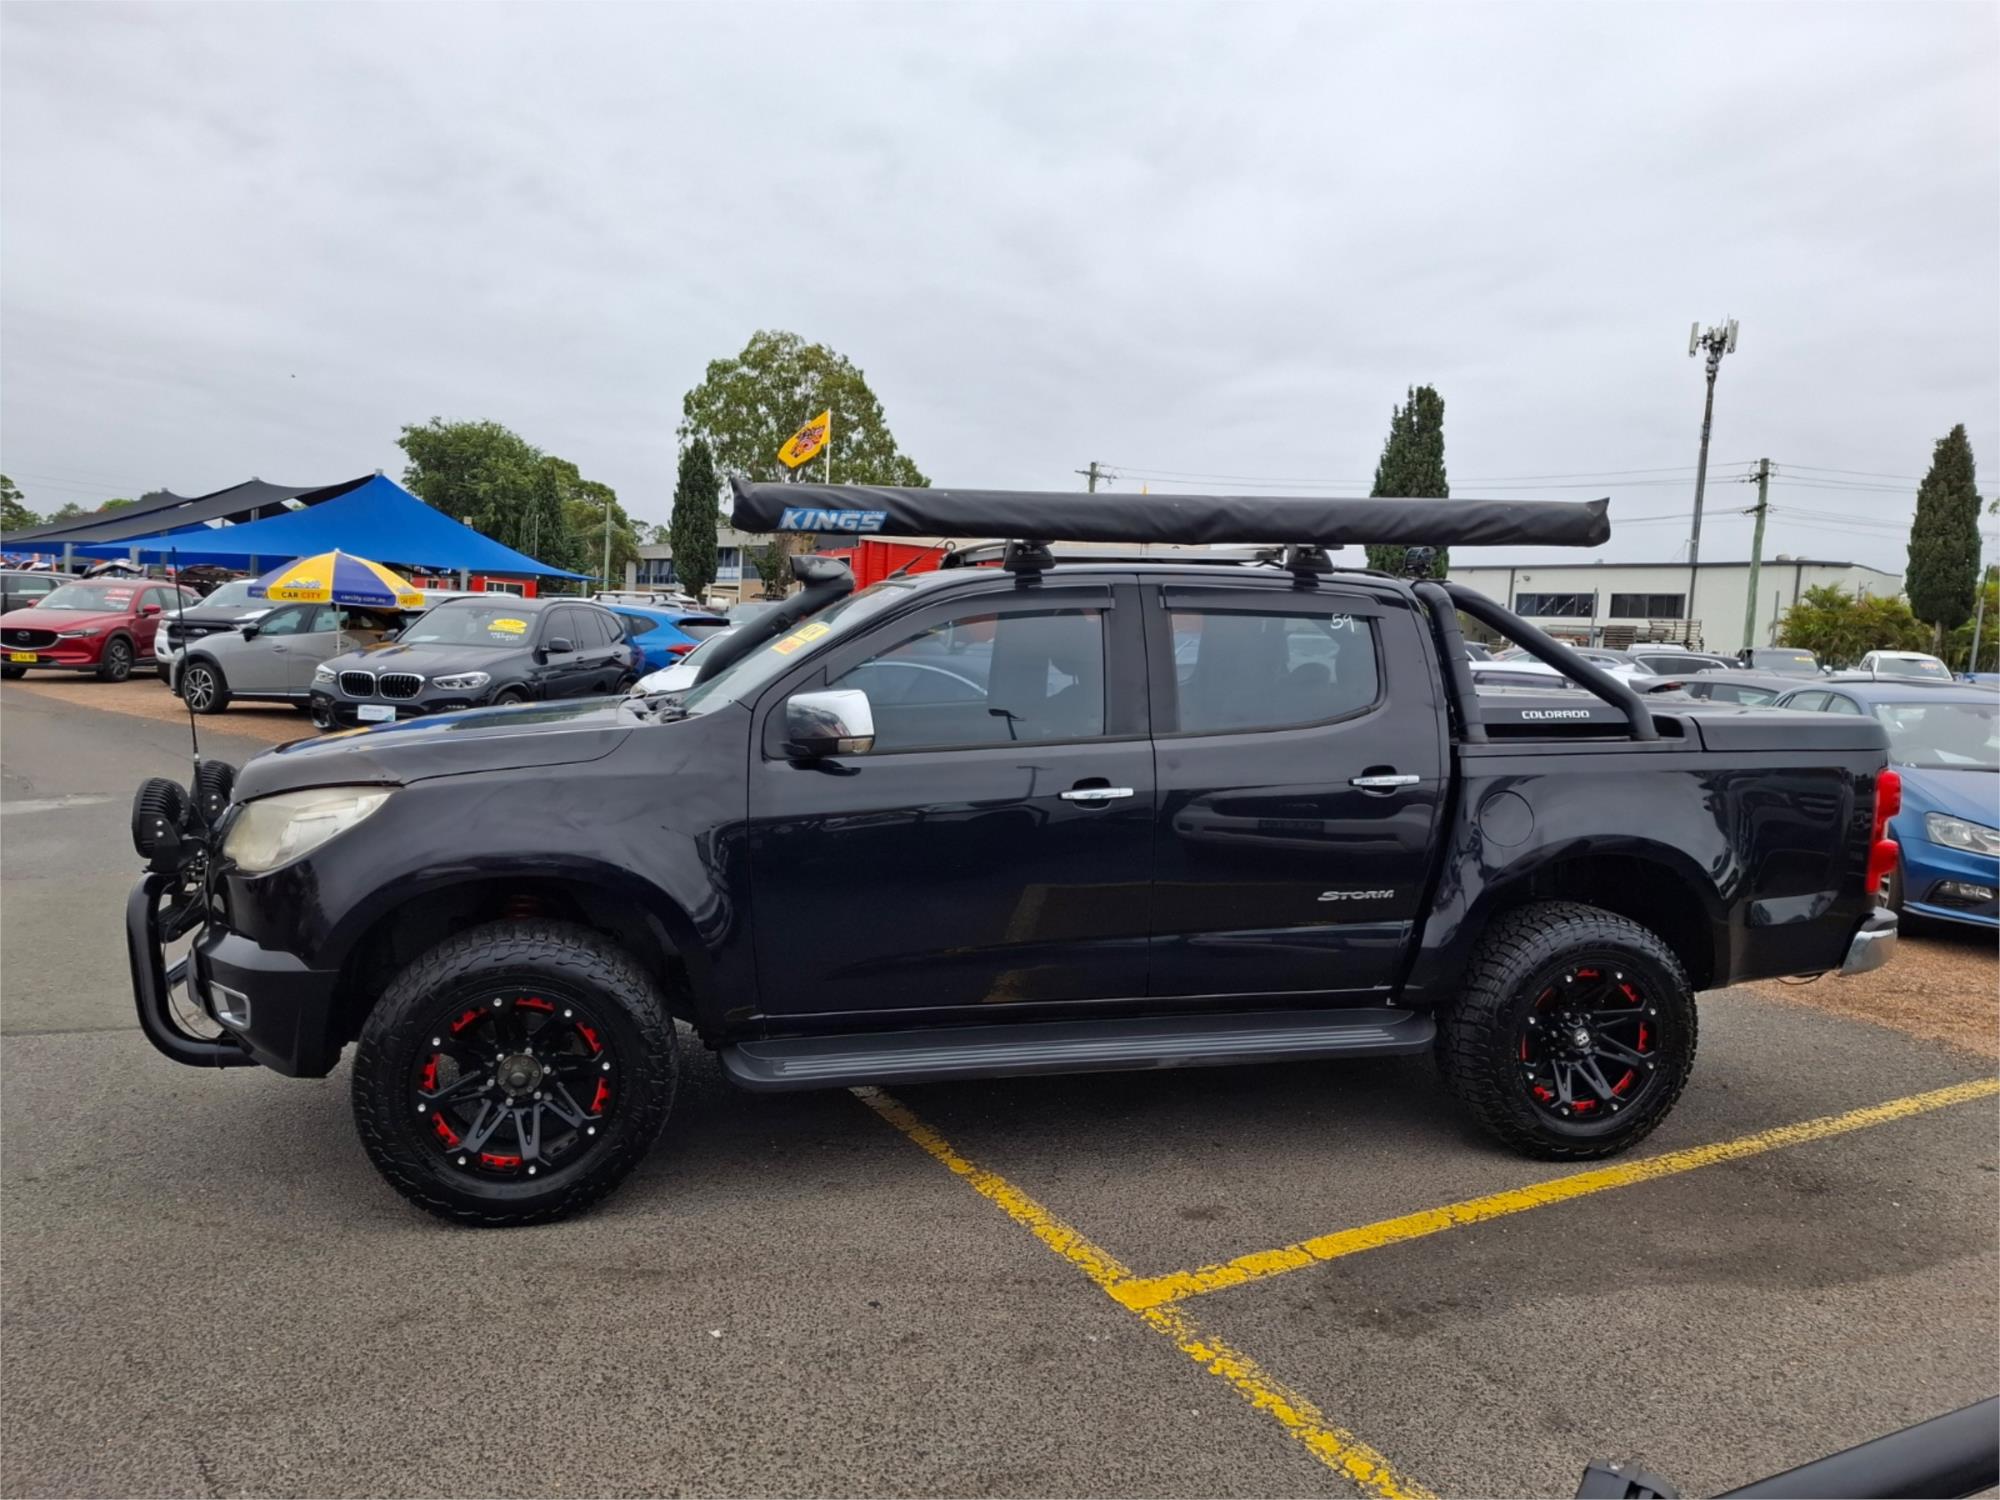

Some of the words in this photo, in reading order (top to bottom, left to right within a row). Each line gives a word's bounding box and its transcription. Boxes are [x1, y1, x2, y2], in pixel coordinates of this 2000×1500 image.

[780, 510, 885, 531] KINGS
[281, 591, 298, 599] CAR
[301, 592, 321, 600] CITY
[1330, 613, 1355, 633] 59
[1521, 710, 1590, 719] COLORADO
